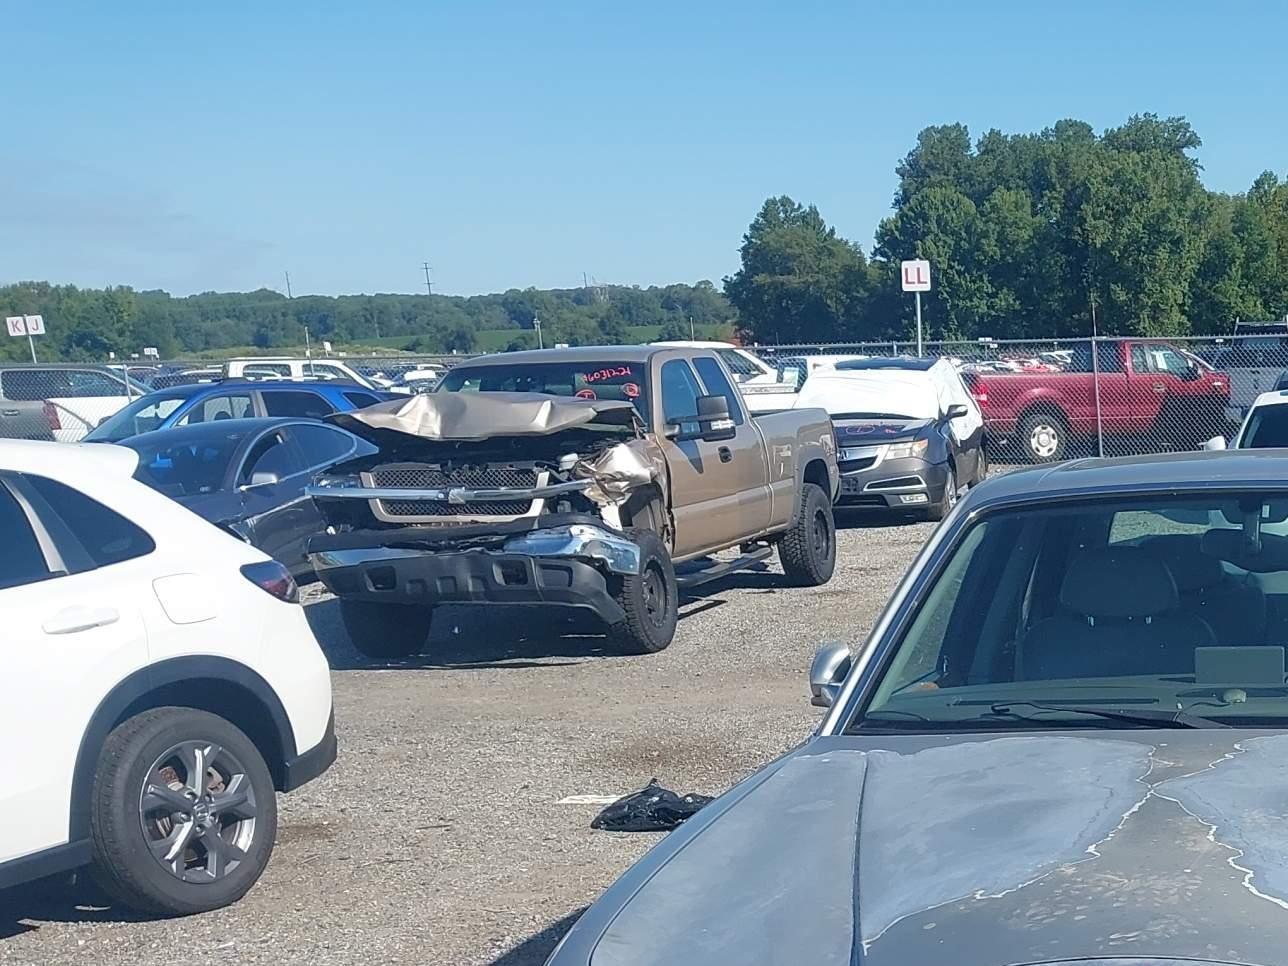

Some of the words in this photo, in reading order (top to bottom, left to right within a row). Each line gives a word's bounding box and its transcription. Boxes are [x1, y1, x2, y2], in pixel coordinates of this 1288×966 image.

[904, 267, 928, 285] LL
[11, 320, 22, 333] K
[31, 319, 39, 331] J
